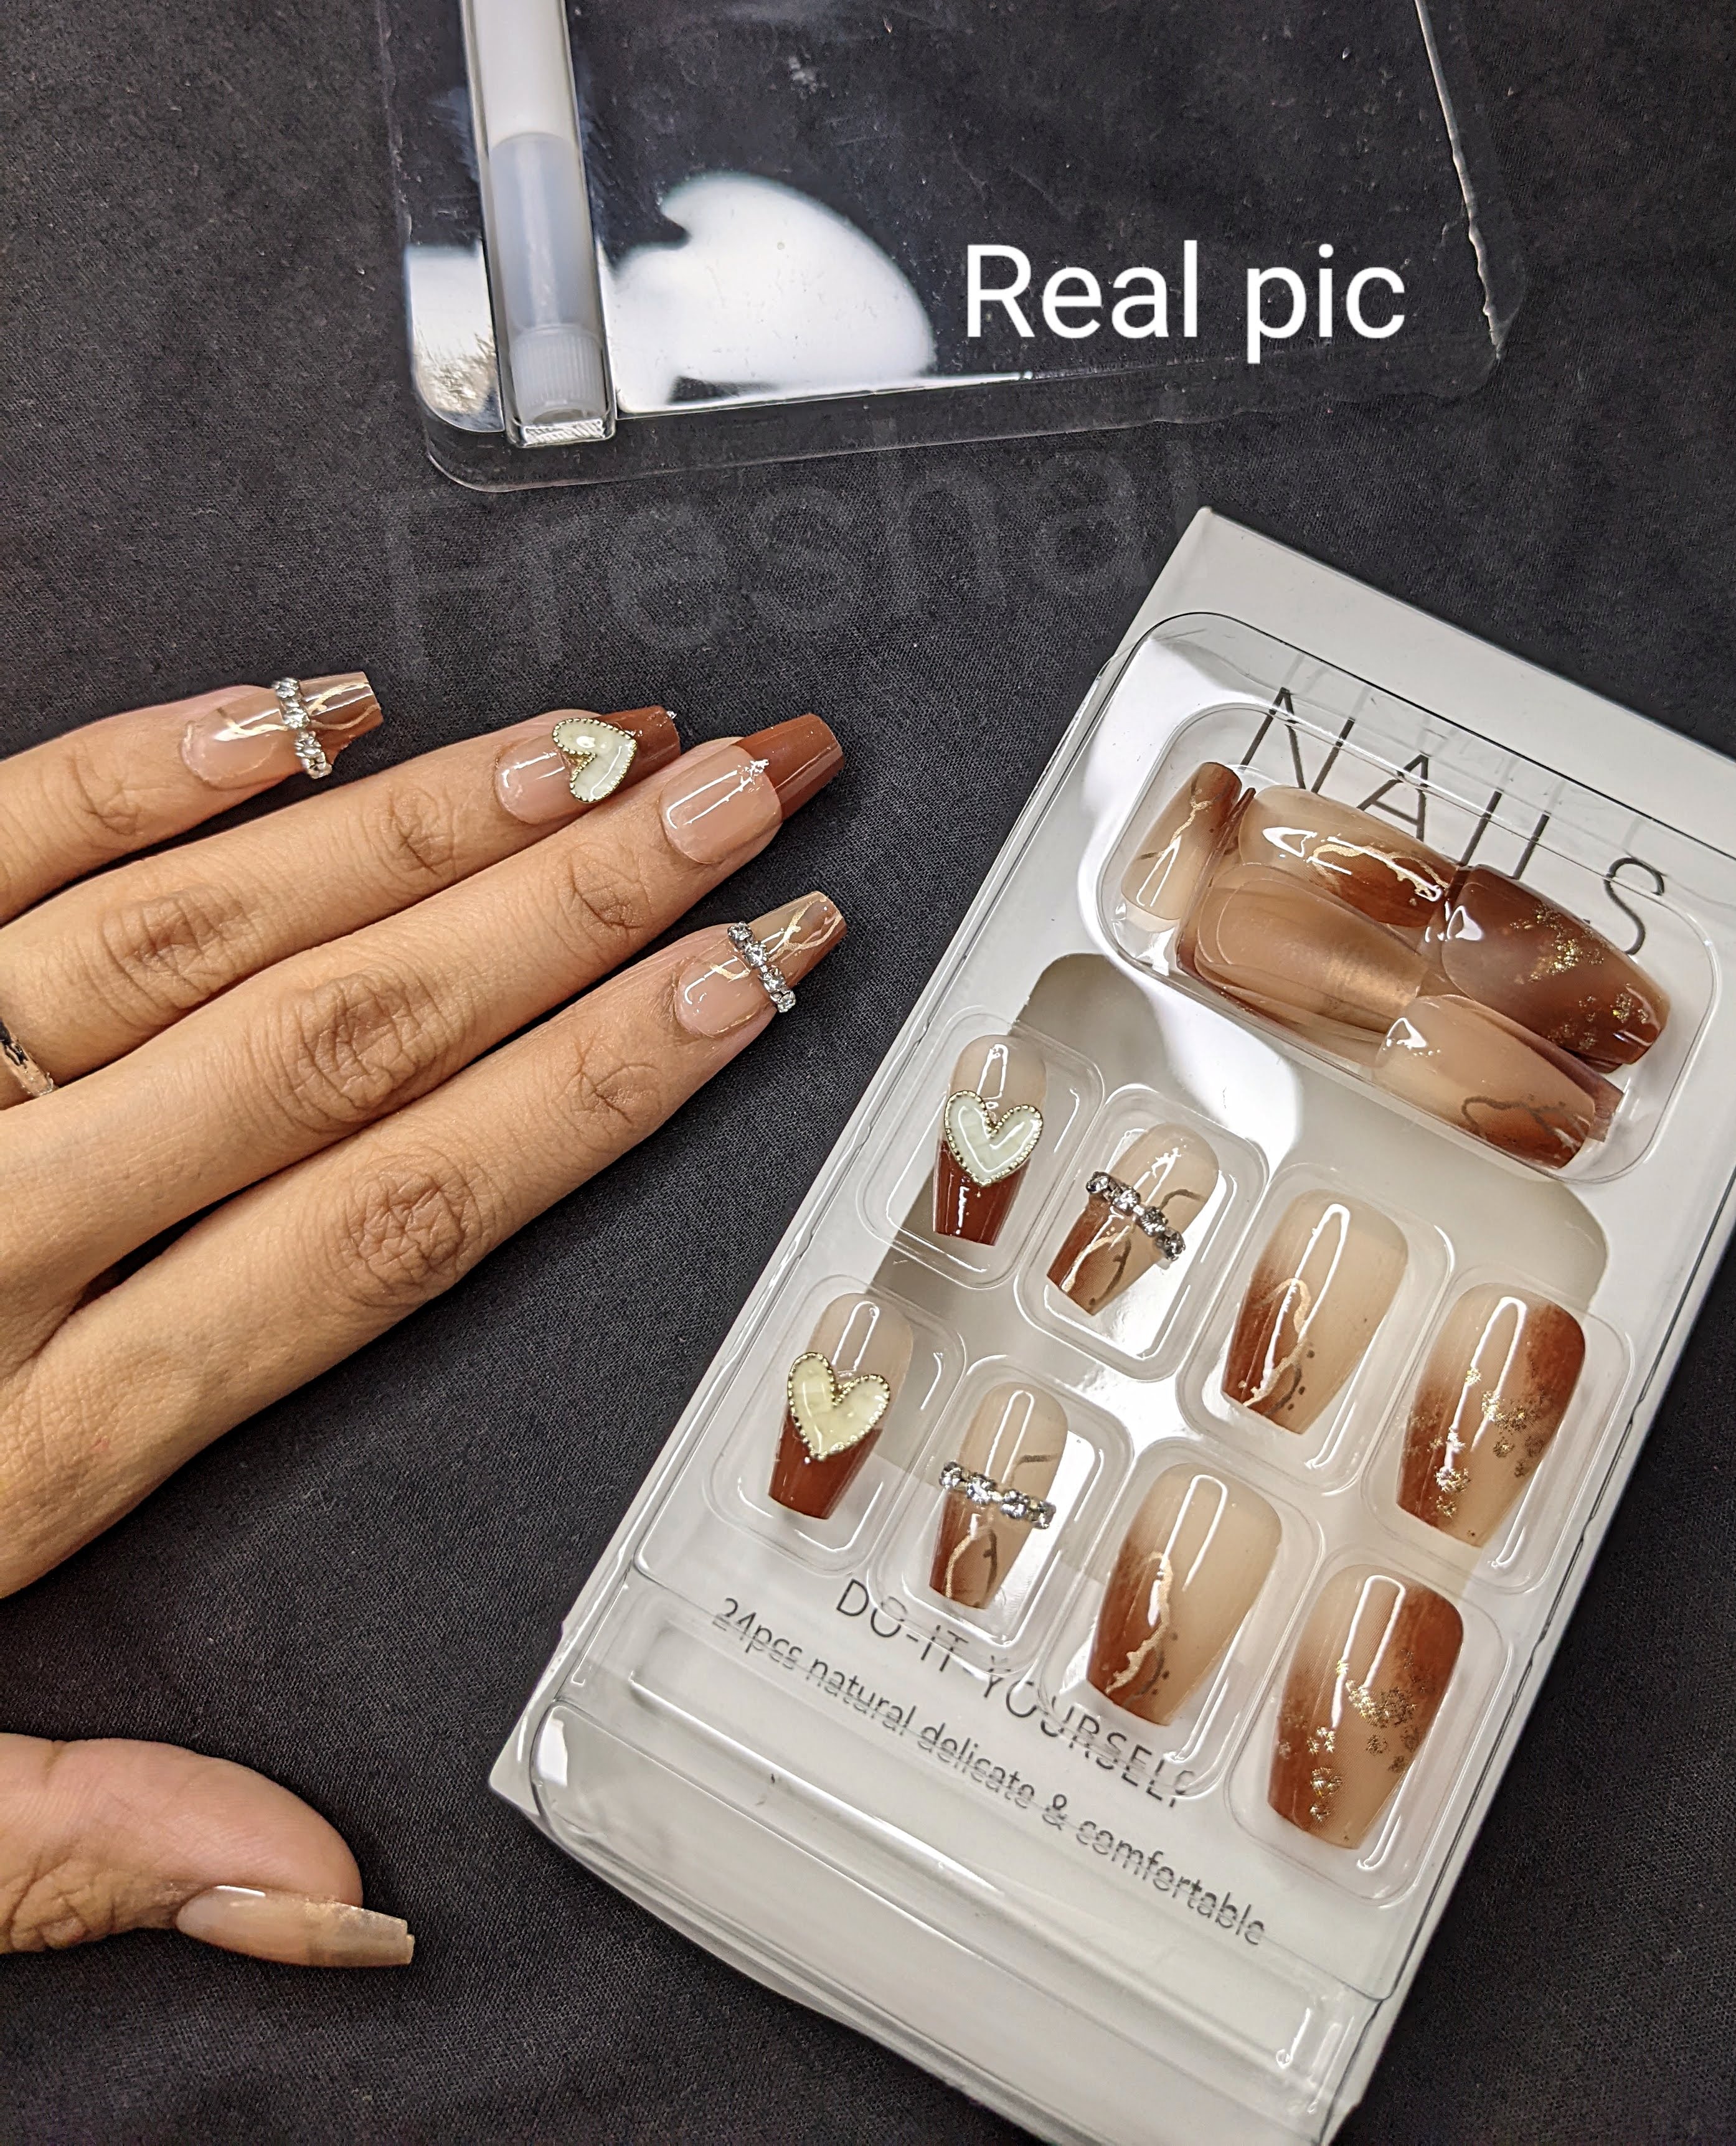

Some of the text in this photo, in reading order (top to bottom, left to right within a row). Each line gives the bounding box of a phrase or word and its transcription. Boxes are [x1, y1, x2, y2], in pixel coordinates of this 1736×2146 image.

[712, 1598, 1266, 1946] 24pcs natural delicate & comfortable
